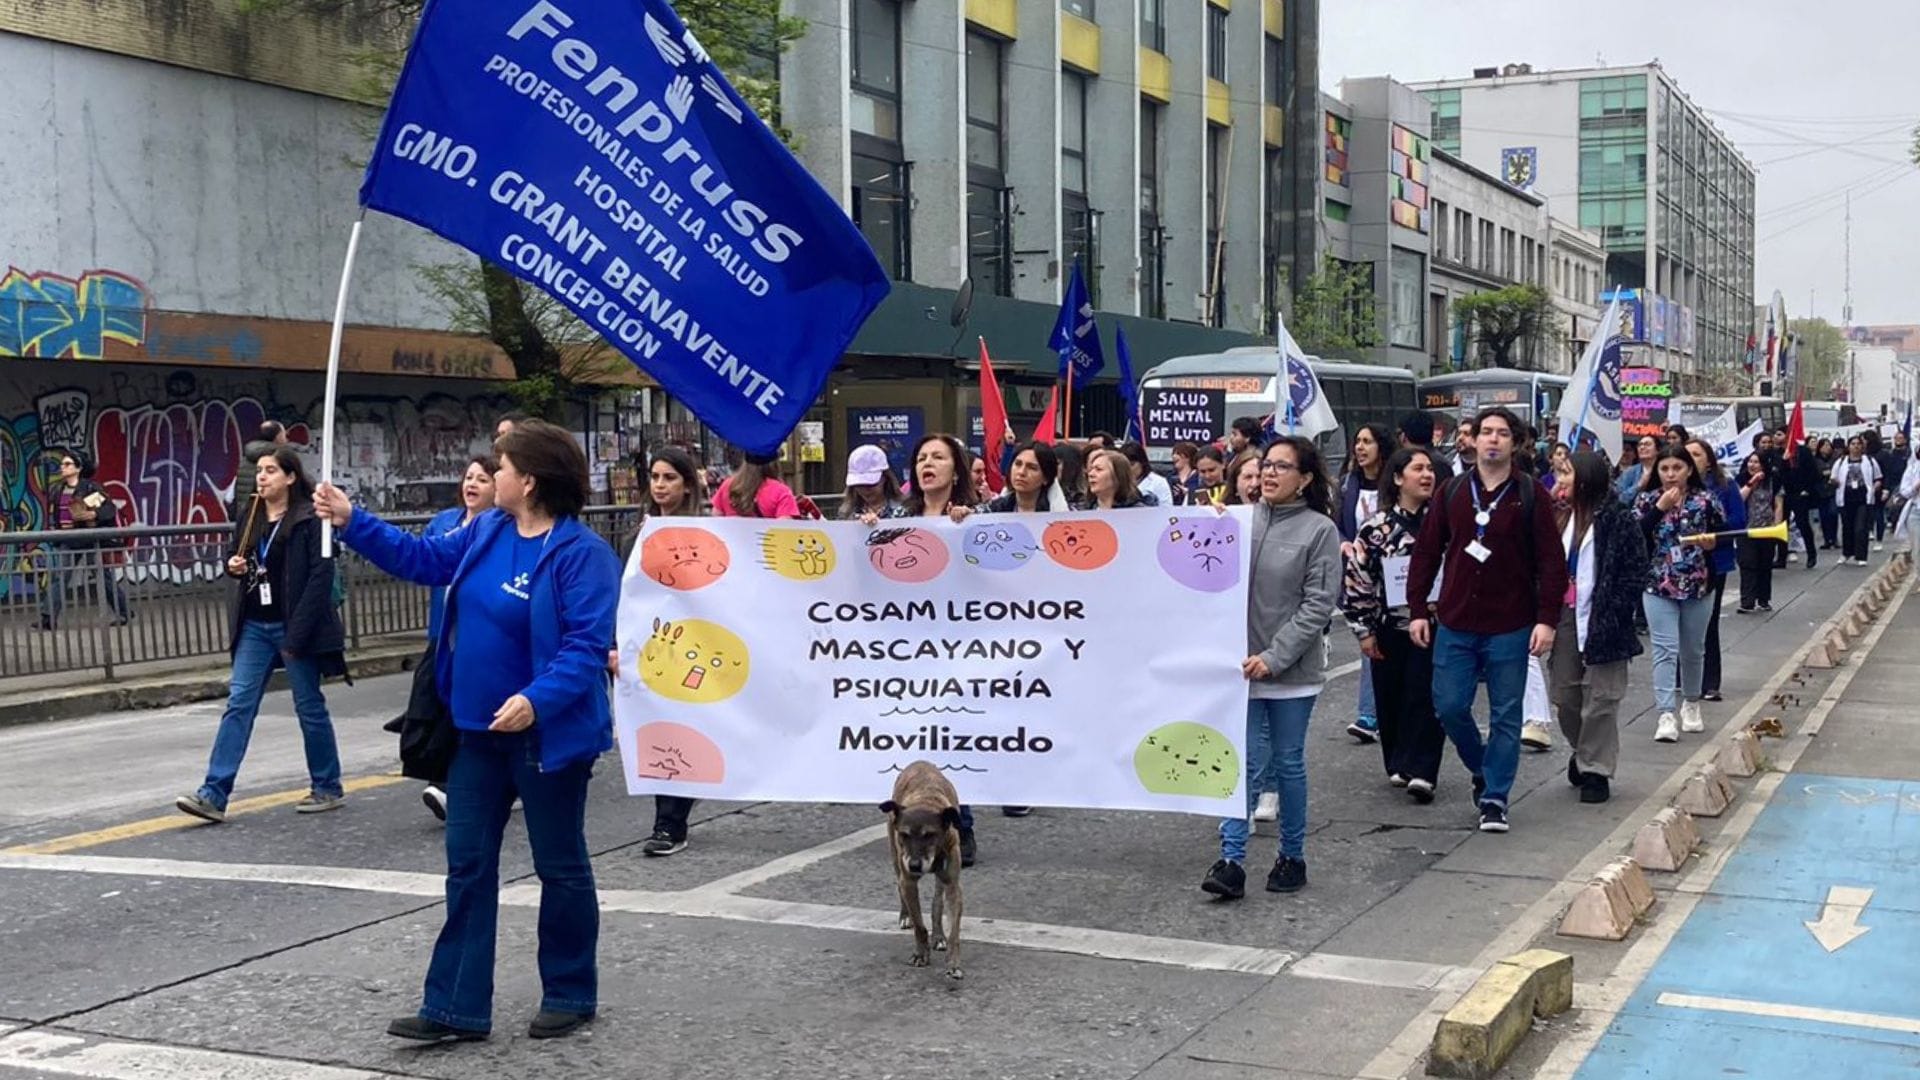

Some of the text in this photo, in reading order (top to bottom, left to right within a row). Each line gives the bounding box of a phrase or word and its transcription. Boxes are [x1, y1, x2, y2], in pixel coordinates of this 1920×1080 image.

[507, 0, 804, 264] Fenpruss
[484, 54, 770, 297] PROFESIONALES DE LA SALUD
[574, 165, 687, 281] HOSPITAL
[393, 123, 785, 416] GMO. GRANT BENAVENTE
[1157, 392, 1209, 406] SALUD
[1149, 409, 1212, 423] MENTAL
[1150, 427, 1211, 441] DE LUTO
[807, 599, 1085, 623] COSAM LEONOR
[809, 638, 1087, 661] MASCAYANO Y
[832, 670, 1052, 700] PSIQUIATRÍA
[838, 725, 1054, 754] Movilizado
